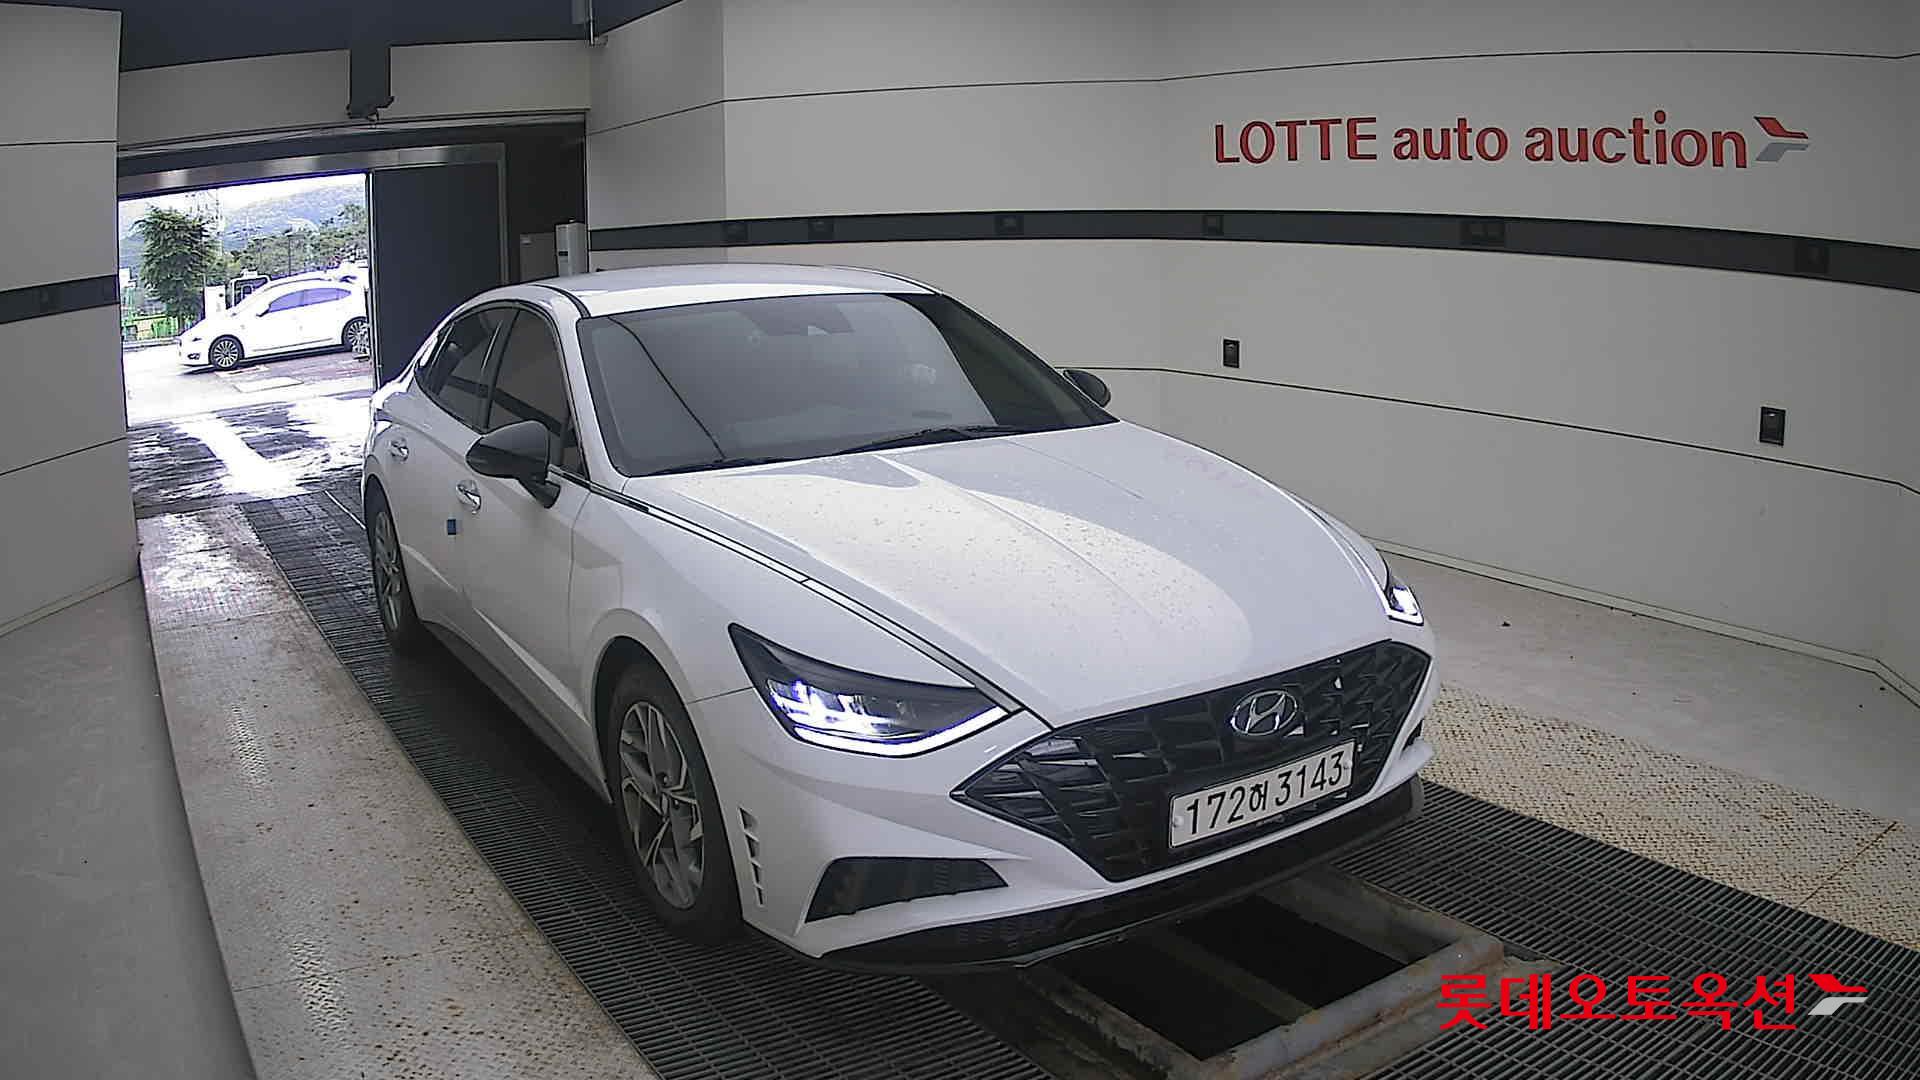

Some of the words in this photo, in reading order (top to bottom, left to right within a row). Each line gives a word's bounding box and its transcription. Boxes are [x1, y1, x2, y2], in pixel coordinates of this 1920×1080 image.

[1215, 117, 1377, 164] LOTTE
[1392, 118, 1508, 161] auto
[1524, 109, 1748, 169] auction
